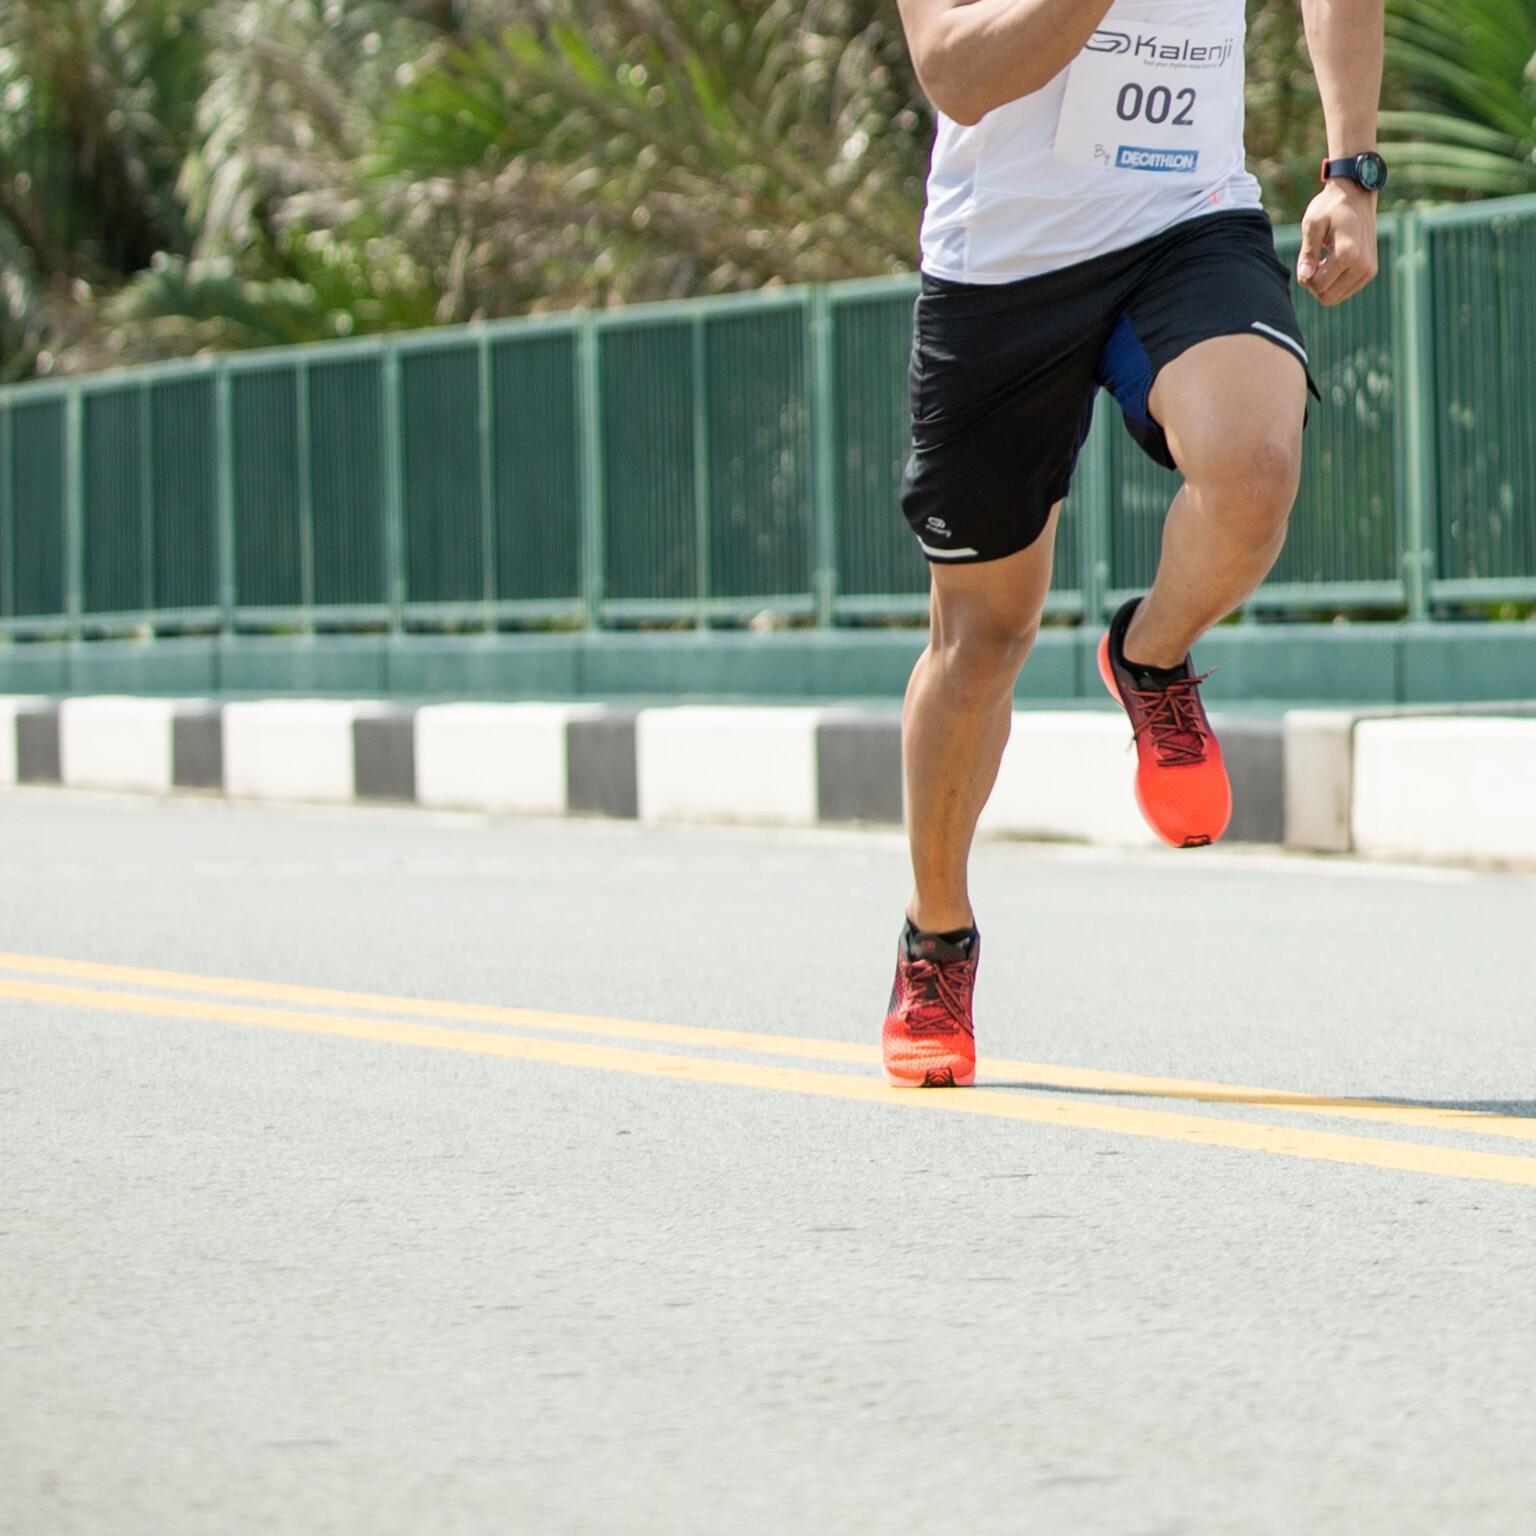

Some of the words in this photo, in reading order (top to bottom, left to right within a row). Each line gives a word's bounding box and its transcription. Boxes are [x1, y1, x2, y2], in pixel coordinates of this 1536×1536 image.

[1134, 35, 1233, 67] Kalenji
[1116, 82, 1197, 125] 002
[1093, 144, 1110, 165] By
[1120, 150, 1194, 169] DECATHLON
